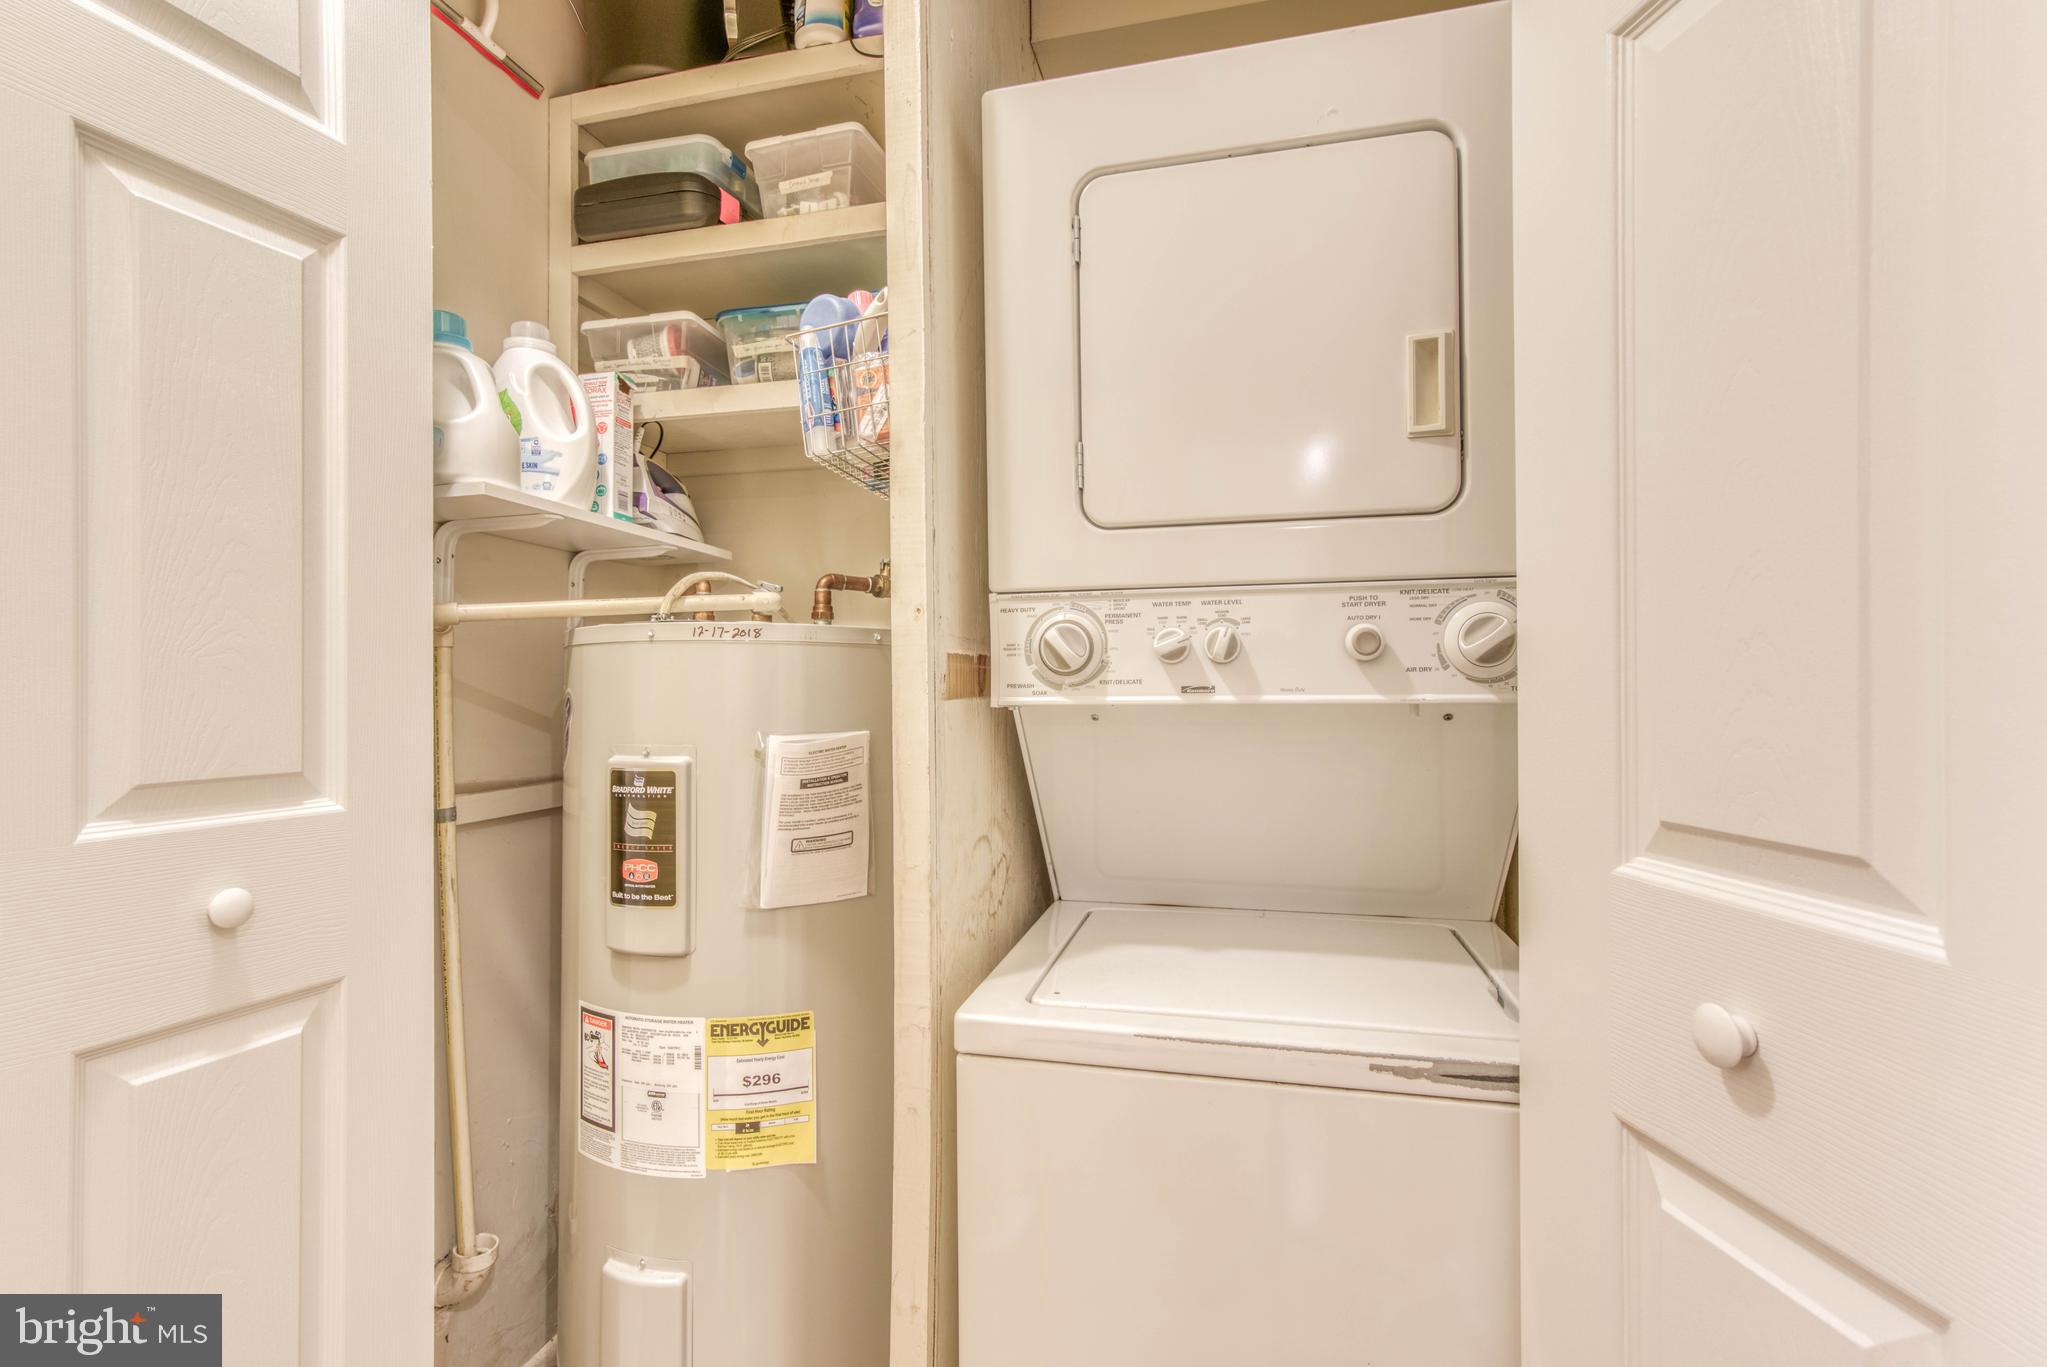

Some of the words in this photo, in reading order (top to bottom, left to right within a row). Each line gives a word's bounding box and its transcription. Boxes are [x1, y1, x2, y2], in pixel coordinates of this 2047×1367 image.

[693, 626, 762, 638] 12-17-2018
[612, 785, 645, 794] BRADFORD
[710, 1016, 810, 1039] ENERGYGUIDE
[743, 1072, 781, 1088] $296
